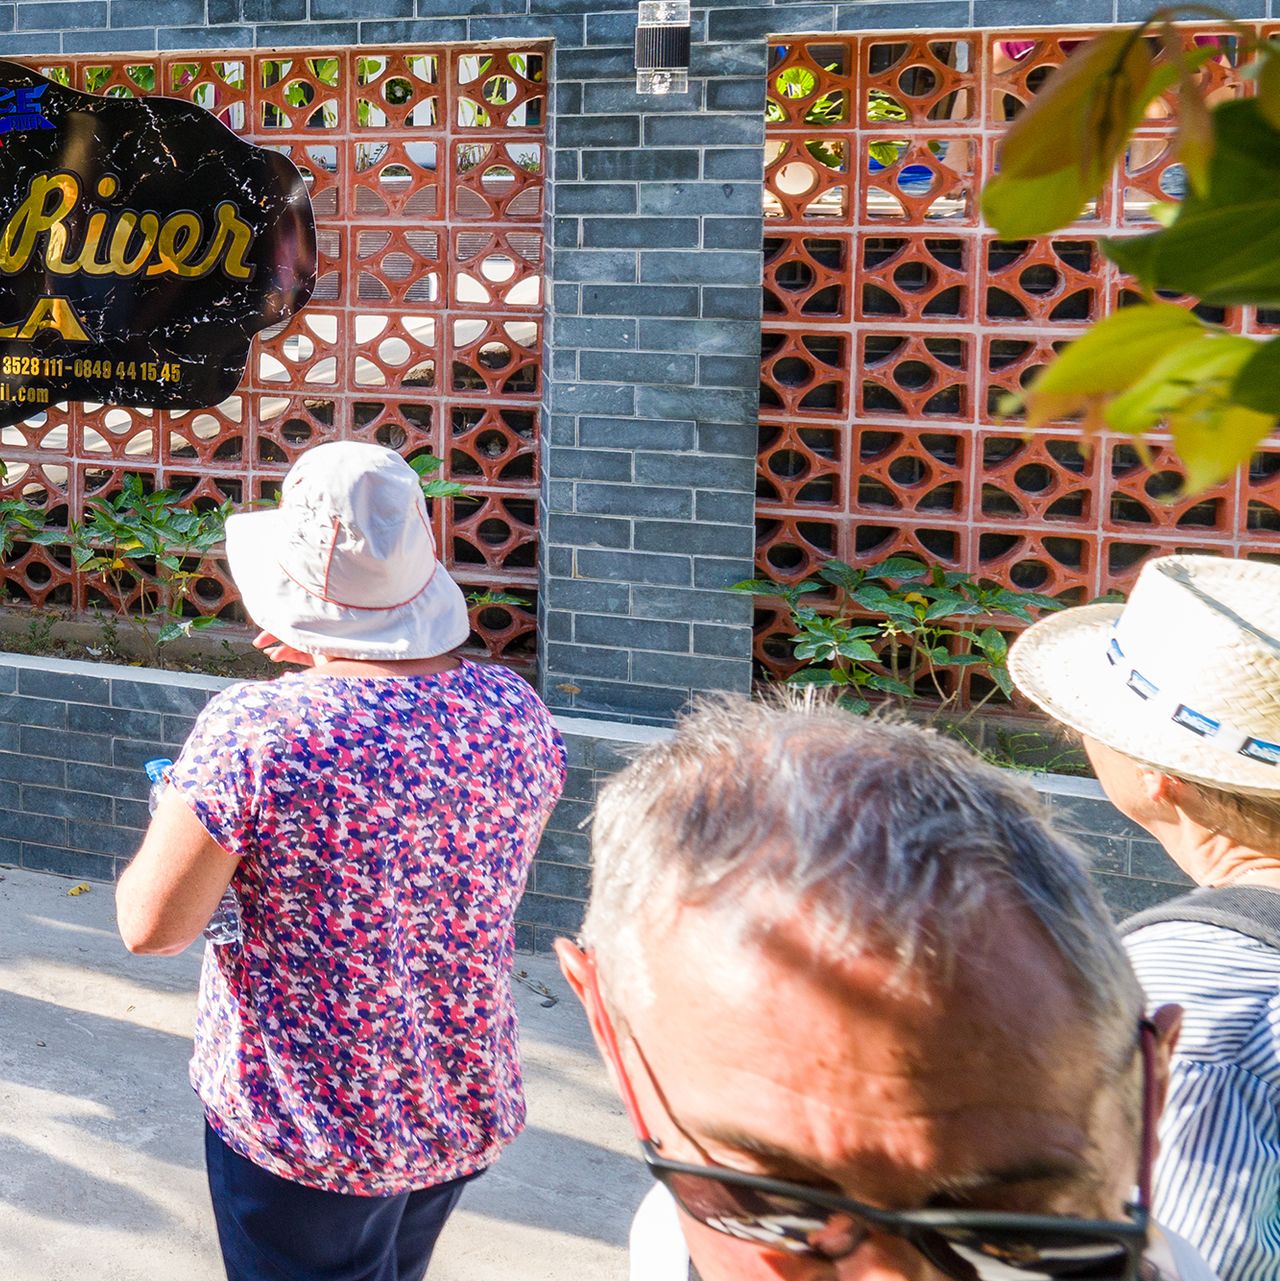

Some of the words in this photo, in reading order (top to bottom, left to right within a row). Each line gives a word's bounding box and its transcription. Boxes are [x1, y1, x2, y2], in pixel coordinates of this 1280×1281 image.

[2, 356, 40, 376] 3528
[115, 361, 137, 380] 44
[140, 362, 157, 381] 15
[160, 362, 181, 382] 45
